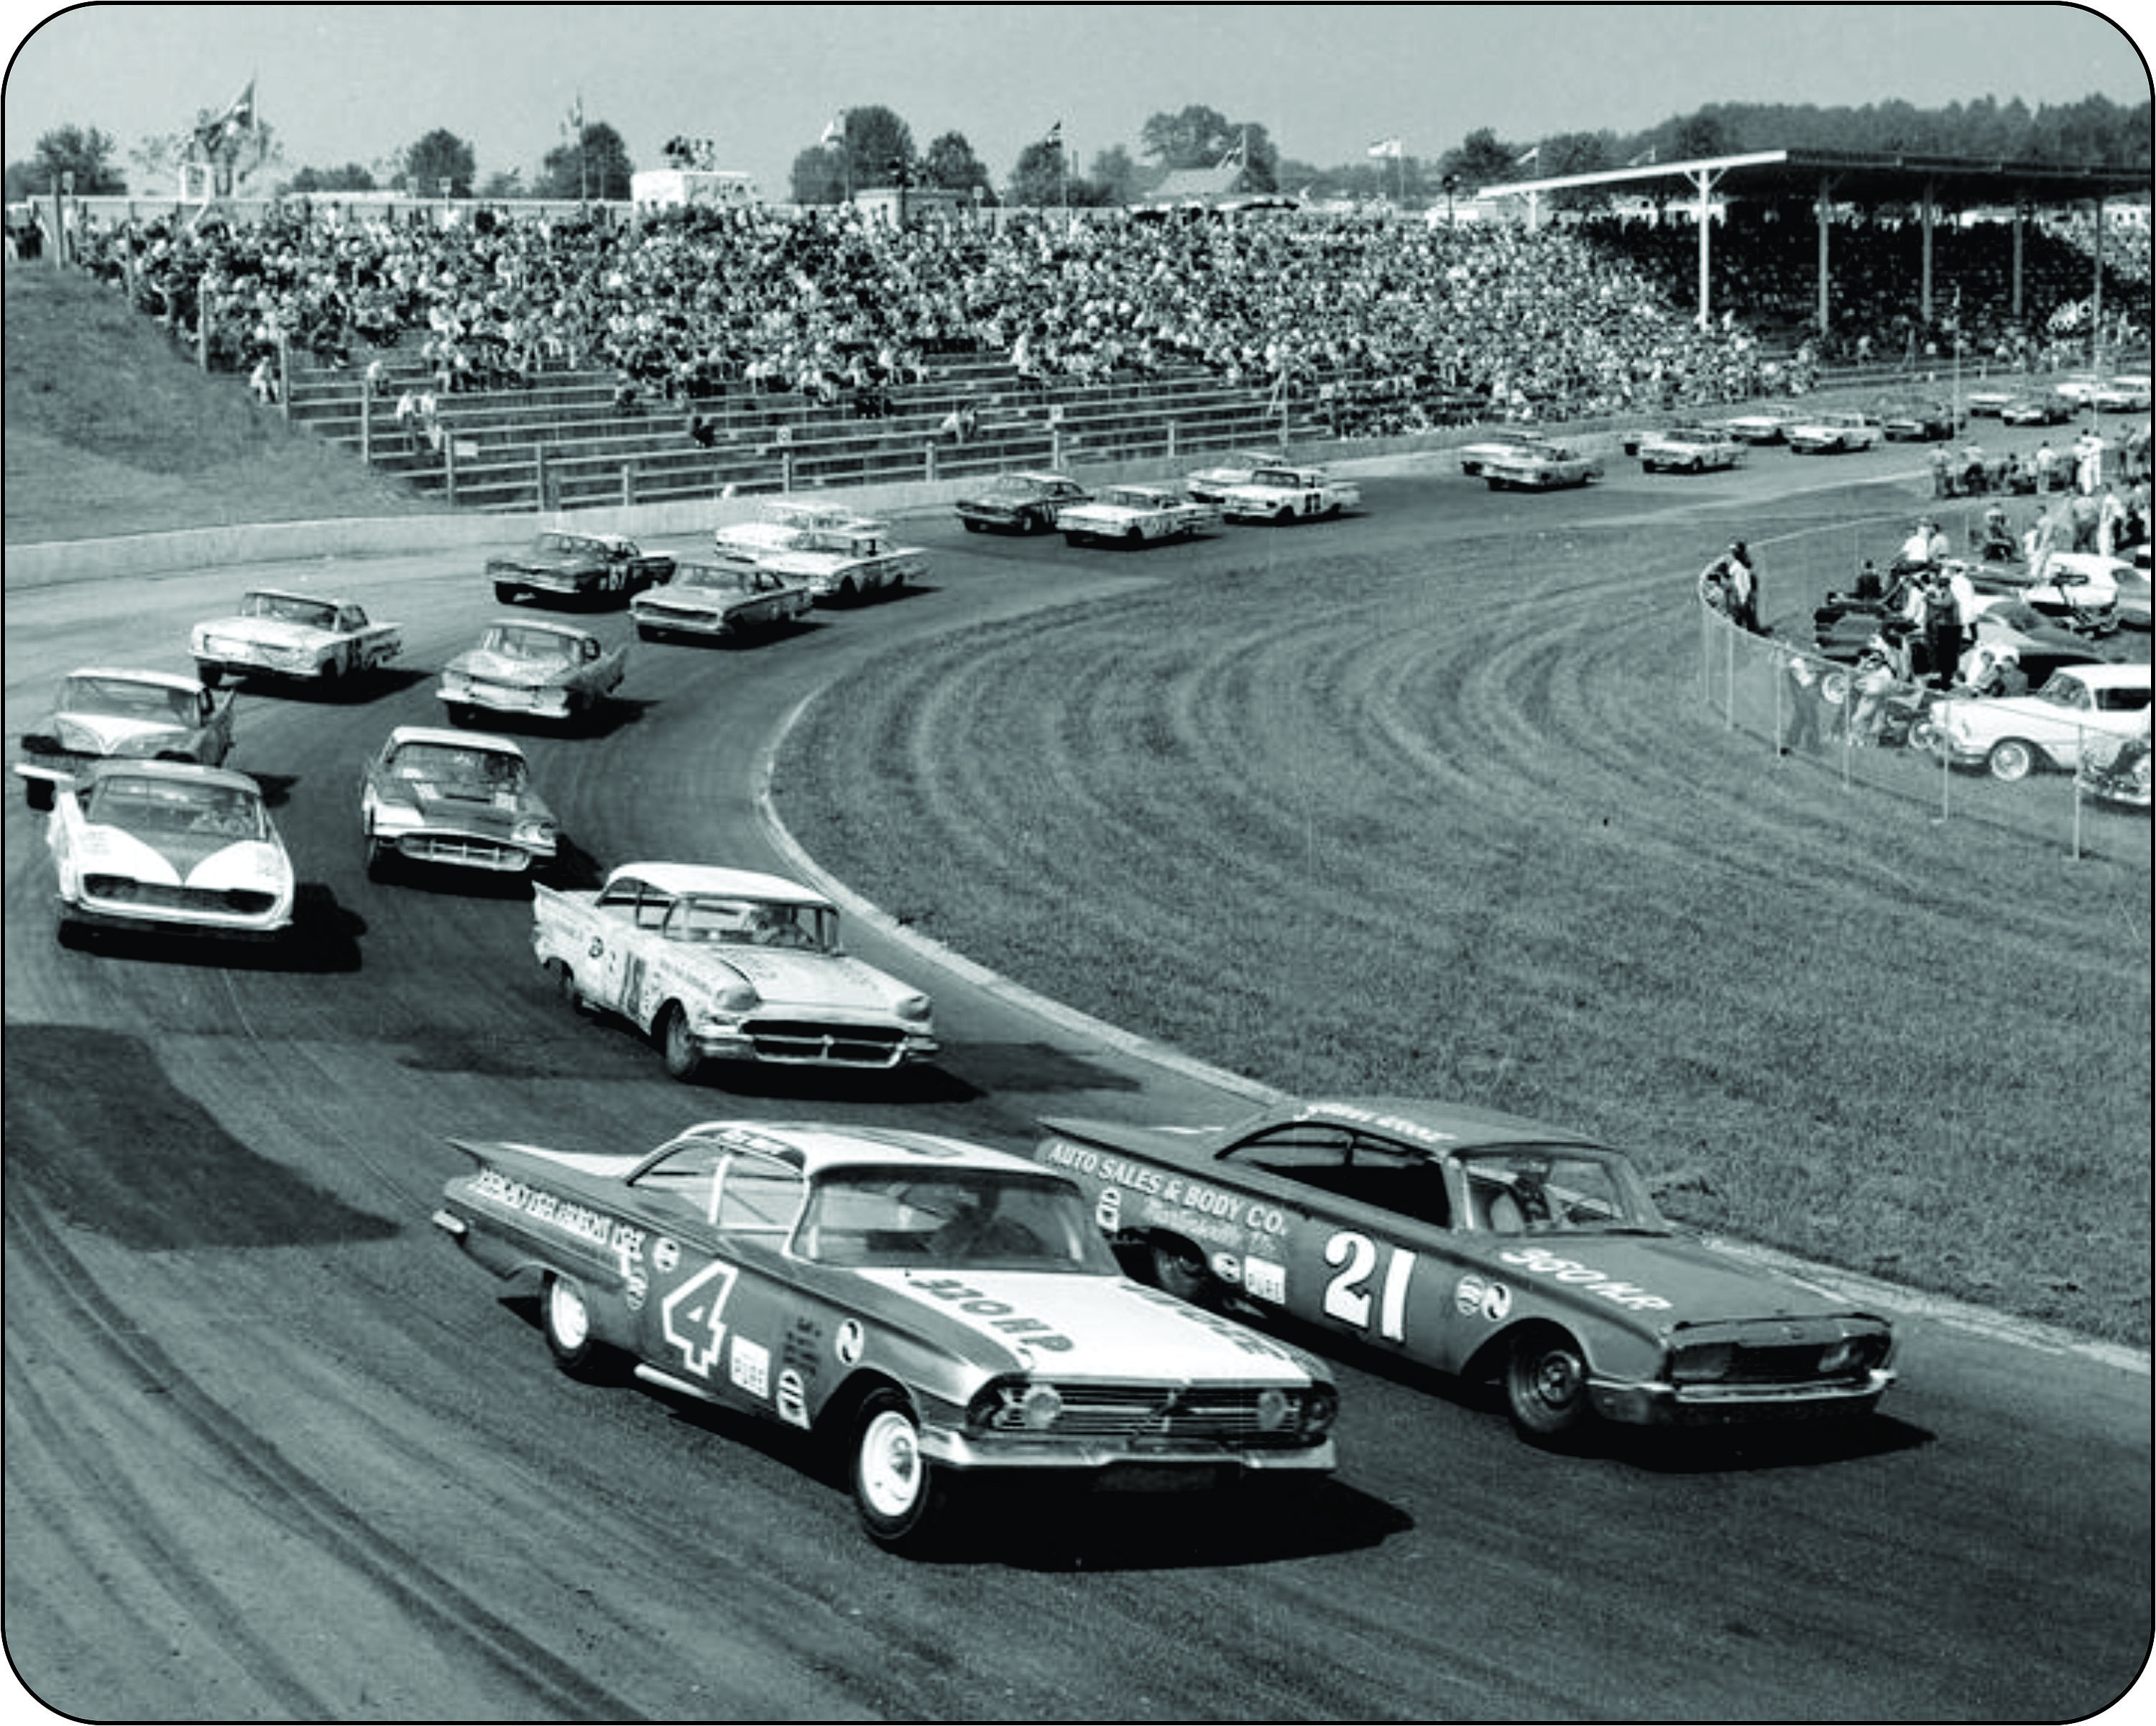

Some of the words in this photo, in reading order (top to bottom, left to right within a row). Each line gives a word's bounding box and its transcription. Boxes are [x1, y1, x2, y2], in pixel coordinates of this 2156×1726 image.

[1047, 1143, 1097, 1173] AUTO
[1099, 1158, 1161, 1194] SALES
[1164, 1180, 1181, 1201] &
[1184, 1186, 1245, 1220] BODY
[1247, 1205, 1287, 1236] CO.
[661, 1260, 740, 1378] 4
[1325, 1231, 1417, 1342] 21
